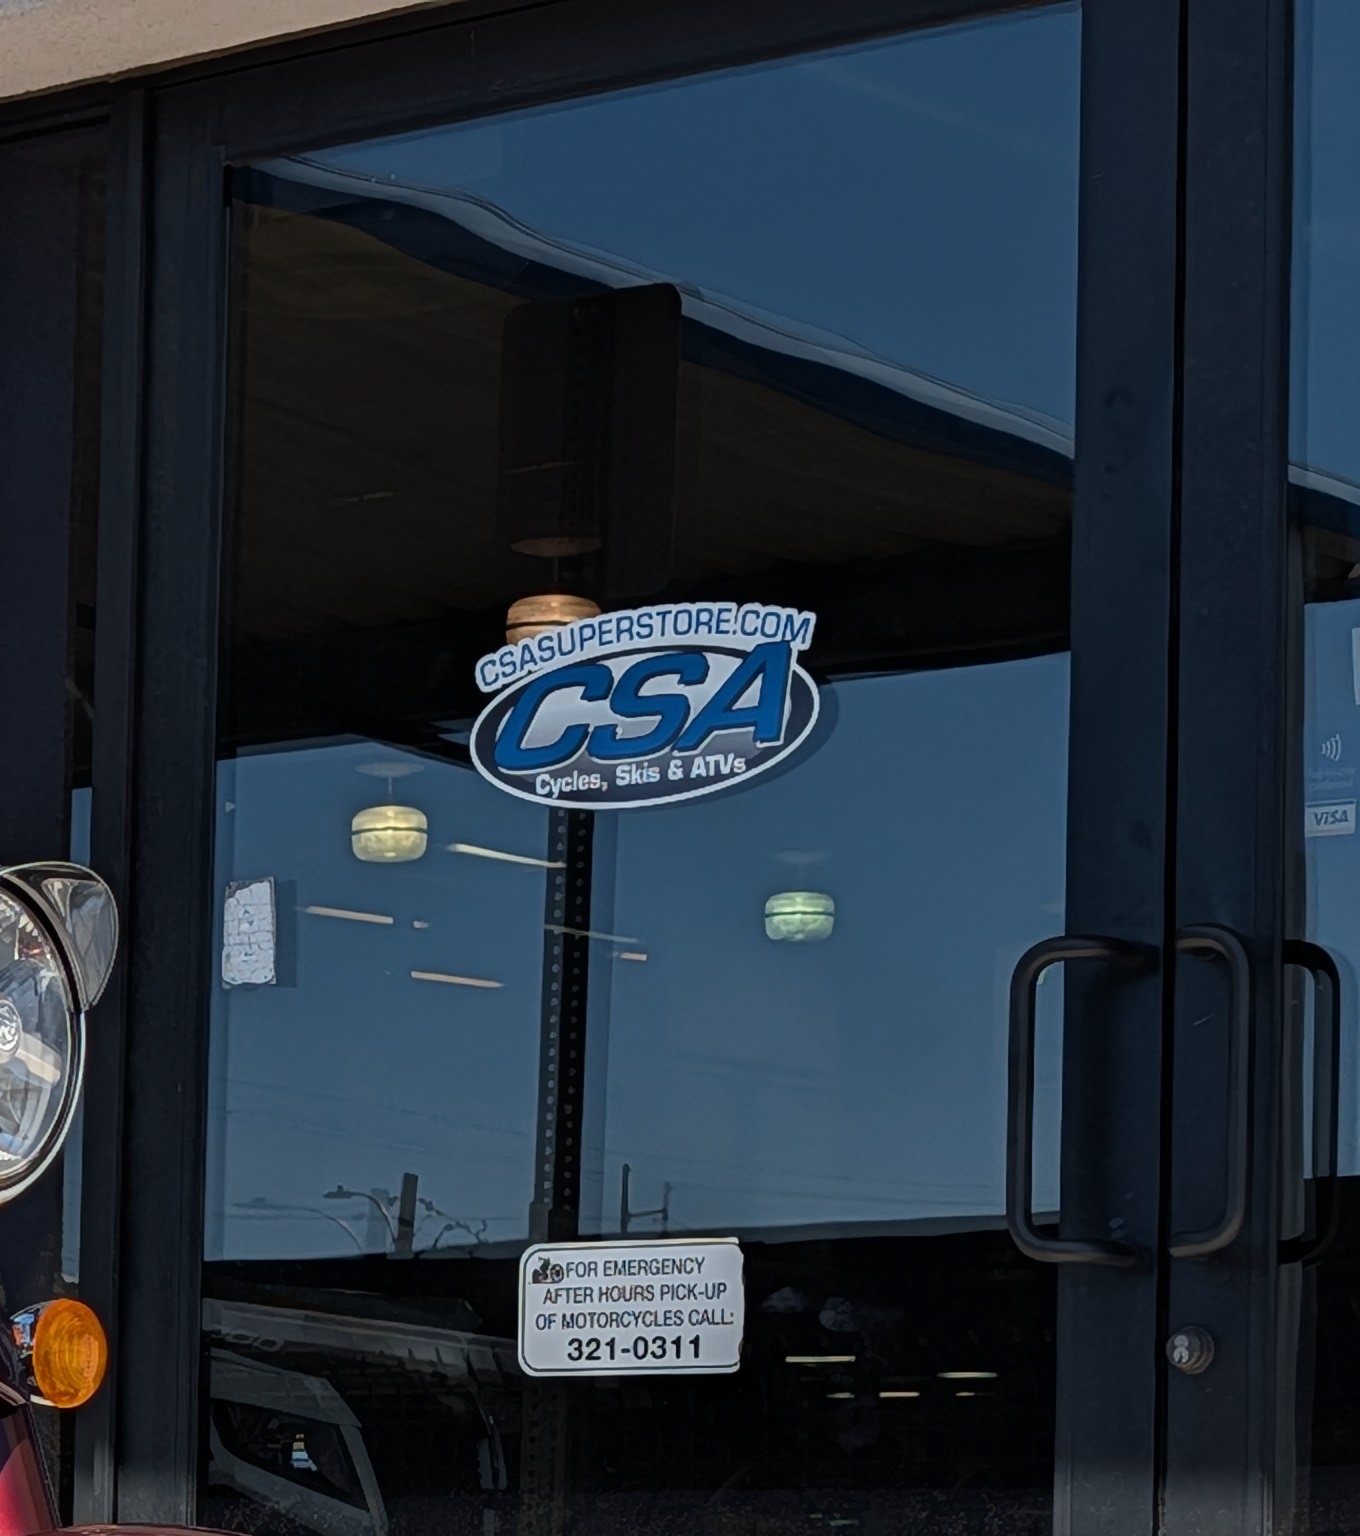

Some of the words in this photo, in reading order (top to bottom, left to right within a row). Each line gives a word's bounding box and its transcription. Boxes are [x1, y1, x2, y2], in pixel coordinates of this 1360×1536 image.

[480, 608, 812, 687] CSASUPERSTORE.COM
[493, 640, 792, 770] CSA
[536, 773, 608, 798] Cycles,
[615, 763, 660, 787] Skis
[667, 758, 684, 781] &
[691, 752, 747, 778] ATVs
[1312, 809, 1349, 827] VISA
[565, 1260, 598, 1279] FOR
[603, 1257, 706, 1277] EMERGENCY
[543, 1286, 594, 1305] AFTER
[598, 1284, 655, 1303] HOURS
[660, 1282, 728, 1301] PICK-UP
[535, 1313, 557, 1330] OF
[561, 1310, 684, 1330] MOTORCYCLES
[688, 1308, 734, 1326] CALL:
[567, 1334, 701, 1361] 321-0311
